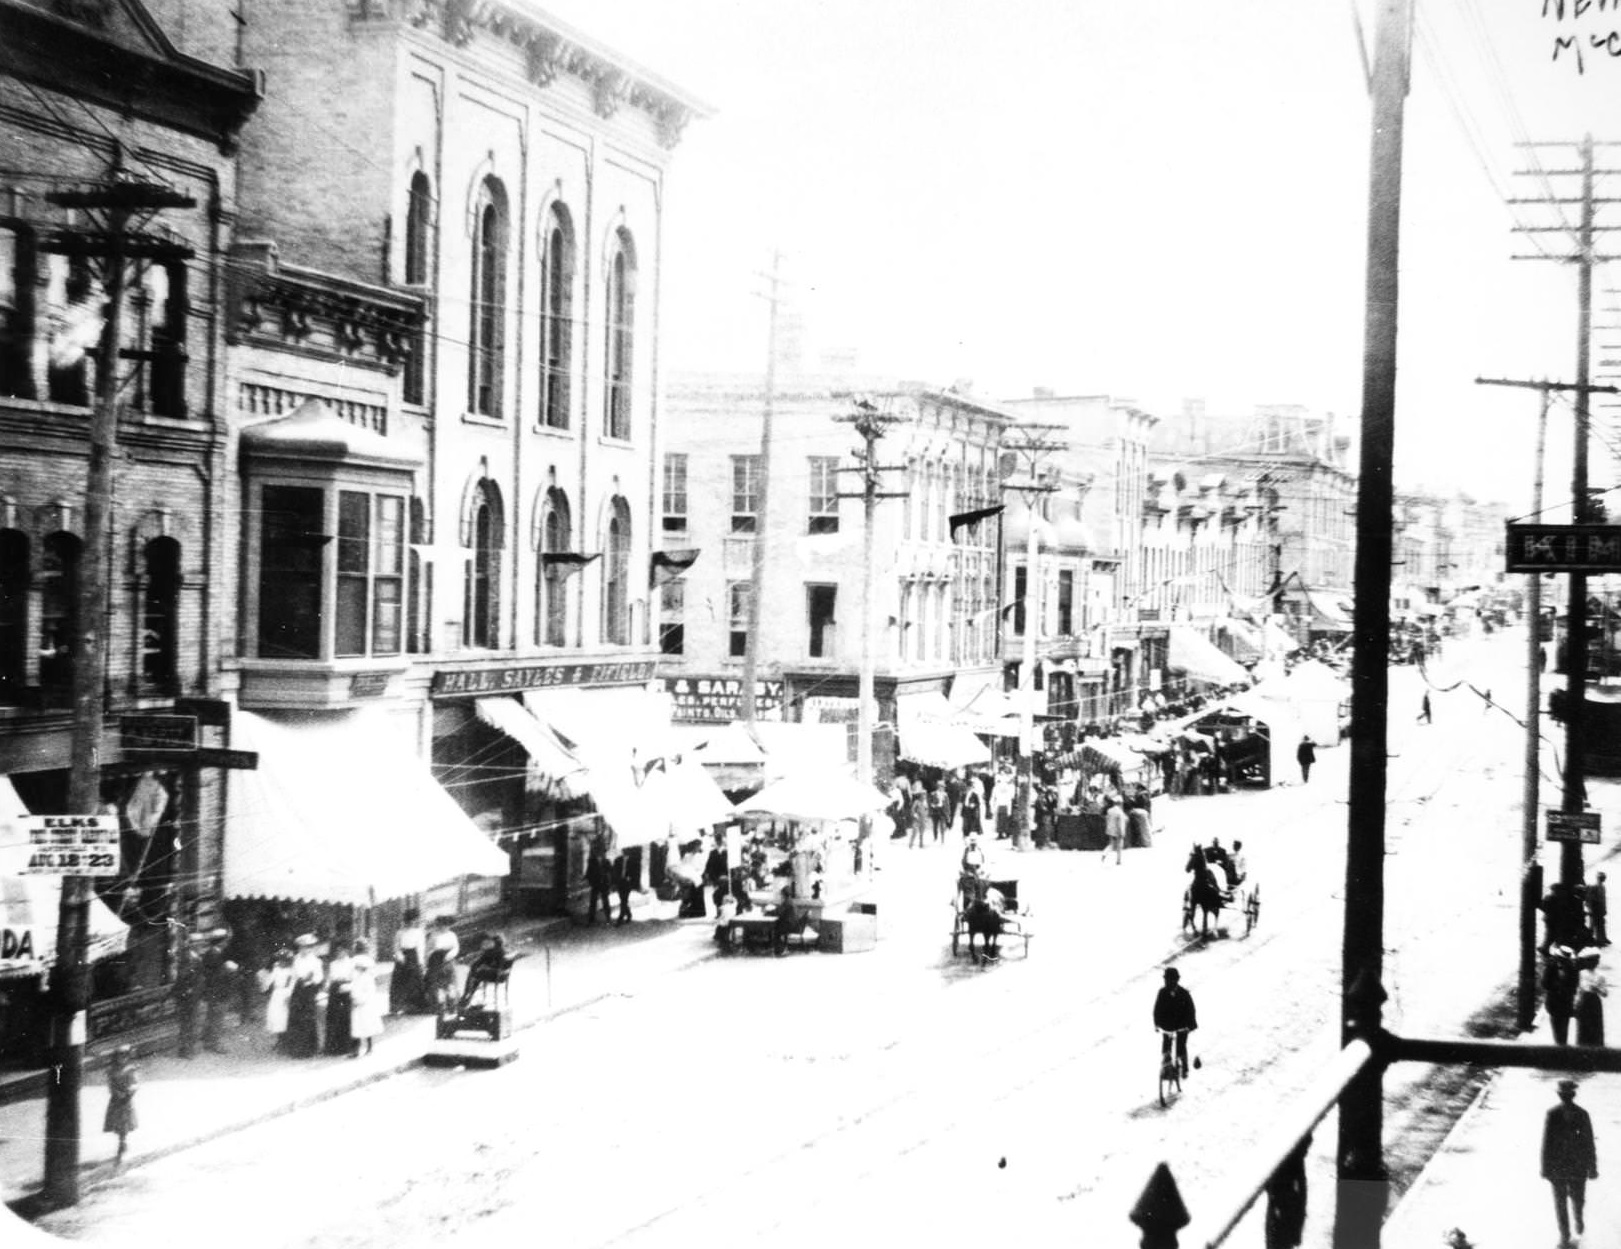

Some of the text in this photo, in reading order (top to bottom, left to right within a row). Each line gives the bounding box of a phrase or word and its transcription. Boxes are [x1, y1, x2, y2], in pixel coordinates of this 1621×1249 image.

[501, 667, 565, 688] SAYLES
[675, 679, 689, 693] &
[45, 818, 98, 827] ELKS
